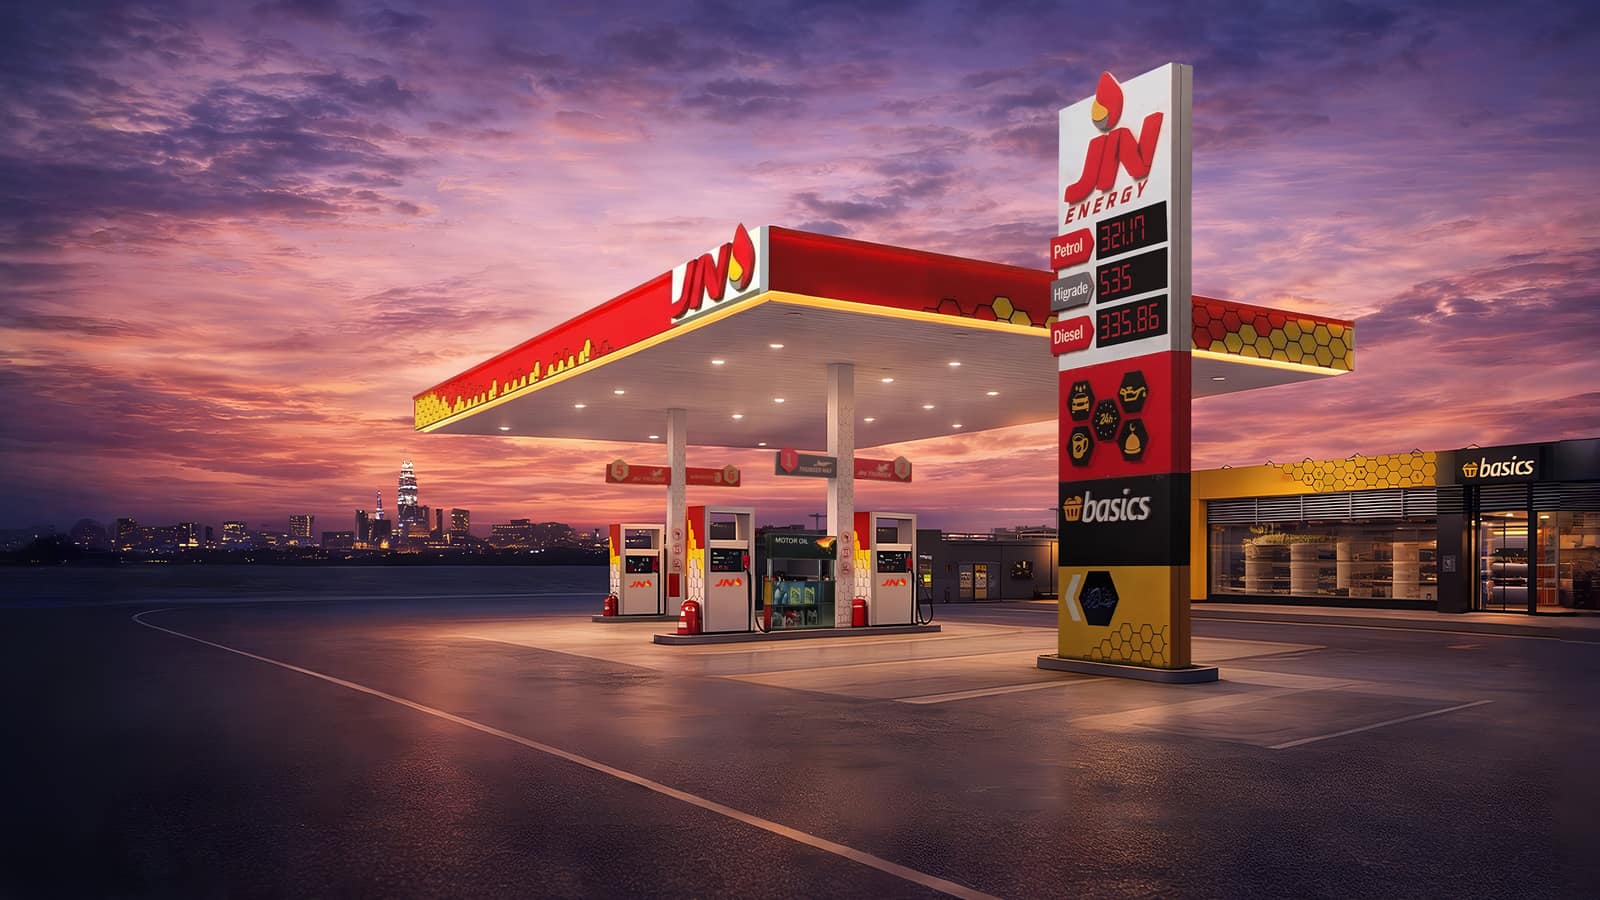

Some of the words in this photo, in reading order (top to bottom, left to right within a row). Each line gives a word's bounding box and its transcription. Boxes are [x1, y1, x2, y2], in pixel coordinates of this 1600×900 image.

[1064, 179, 1148, 225] ENERGY
[1054, 237, 1083, 260] Petrol
[1100, 263, 1132, 296] 535
[1053, 282, 1089, 302] Higrade
[1100, 303, 1160, 340] 335.86
[1054, 324, 1083, 345] Diesel
[1099, 412, 1113, 425] 24h
[615, 463, 624, 476] 5
[1481, 455, 1535, 478] basics
[1082, 488, 1152, 523] basics
[775, 537, 798, 545] MOTOR
